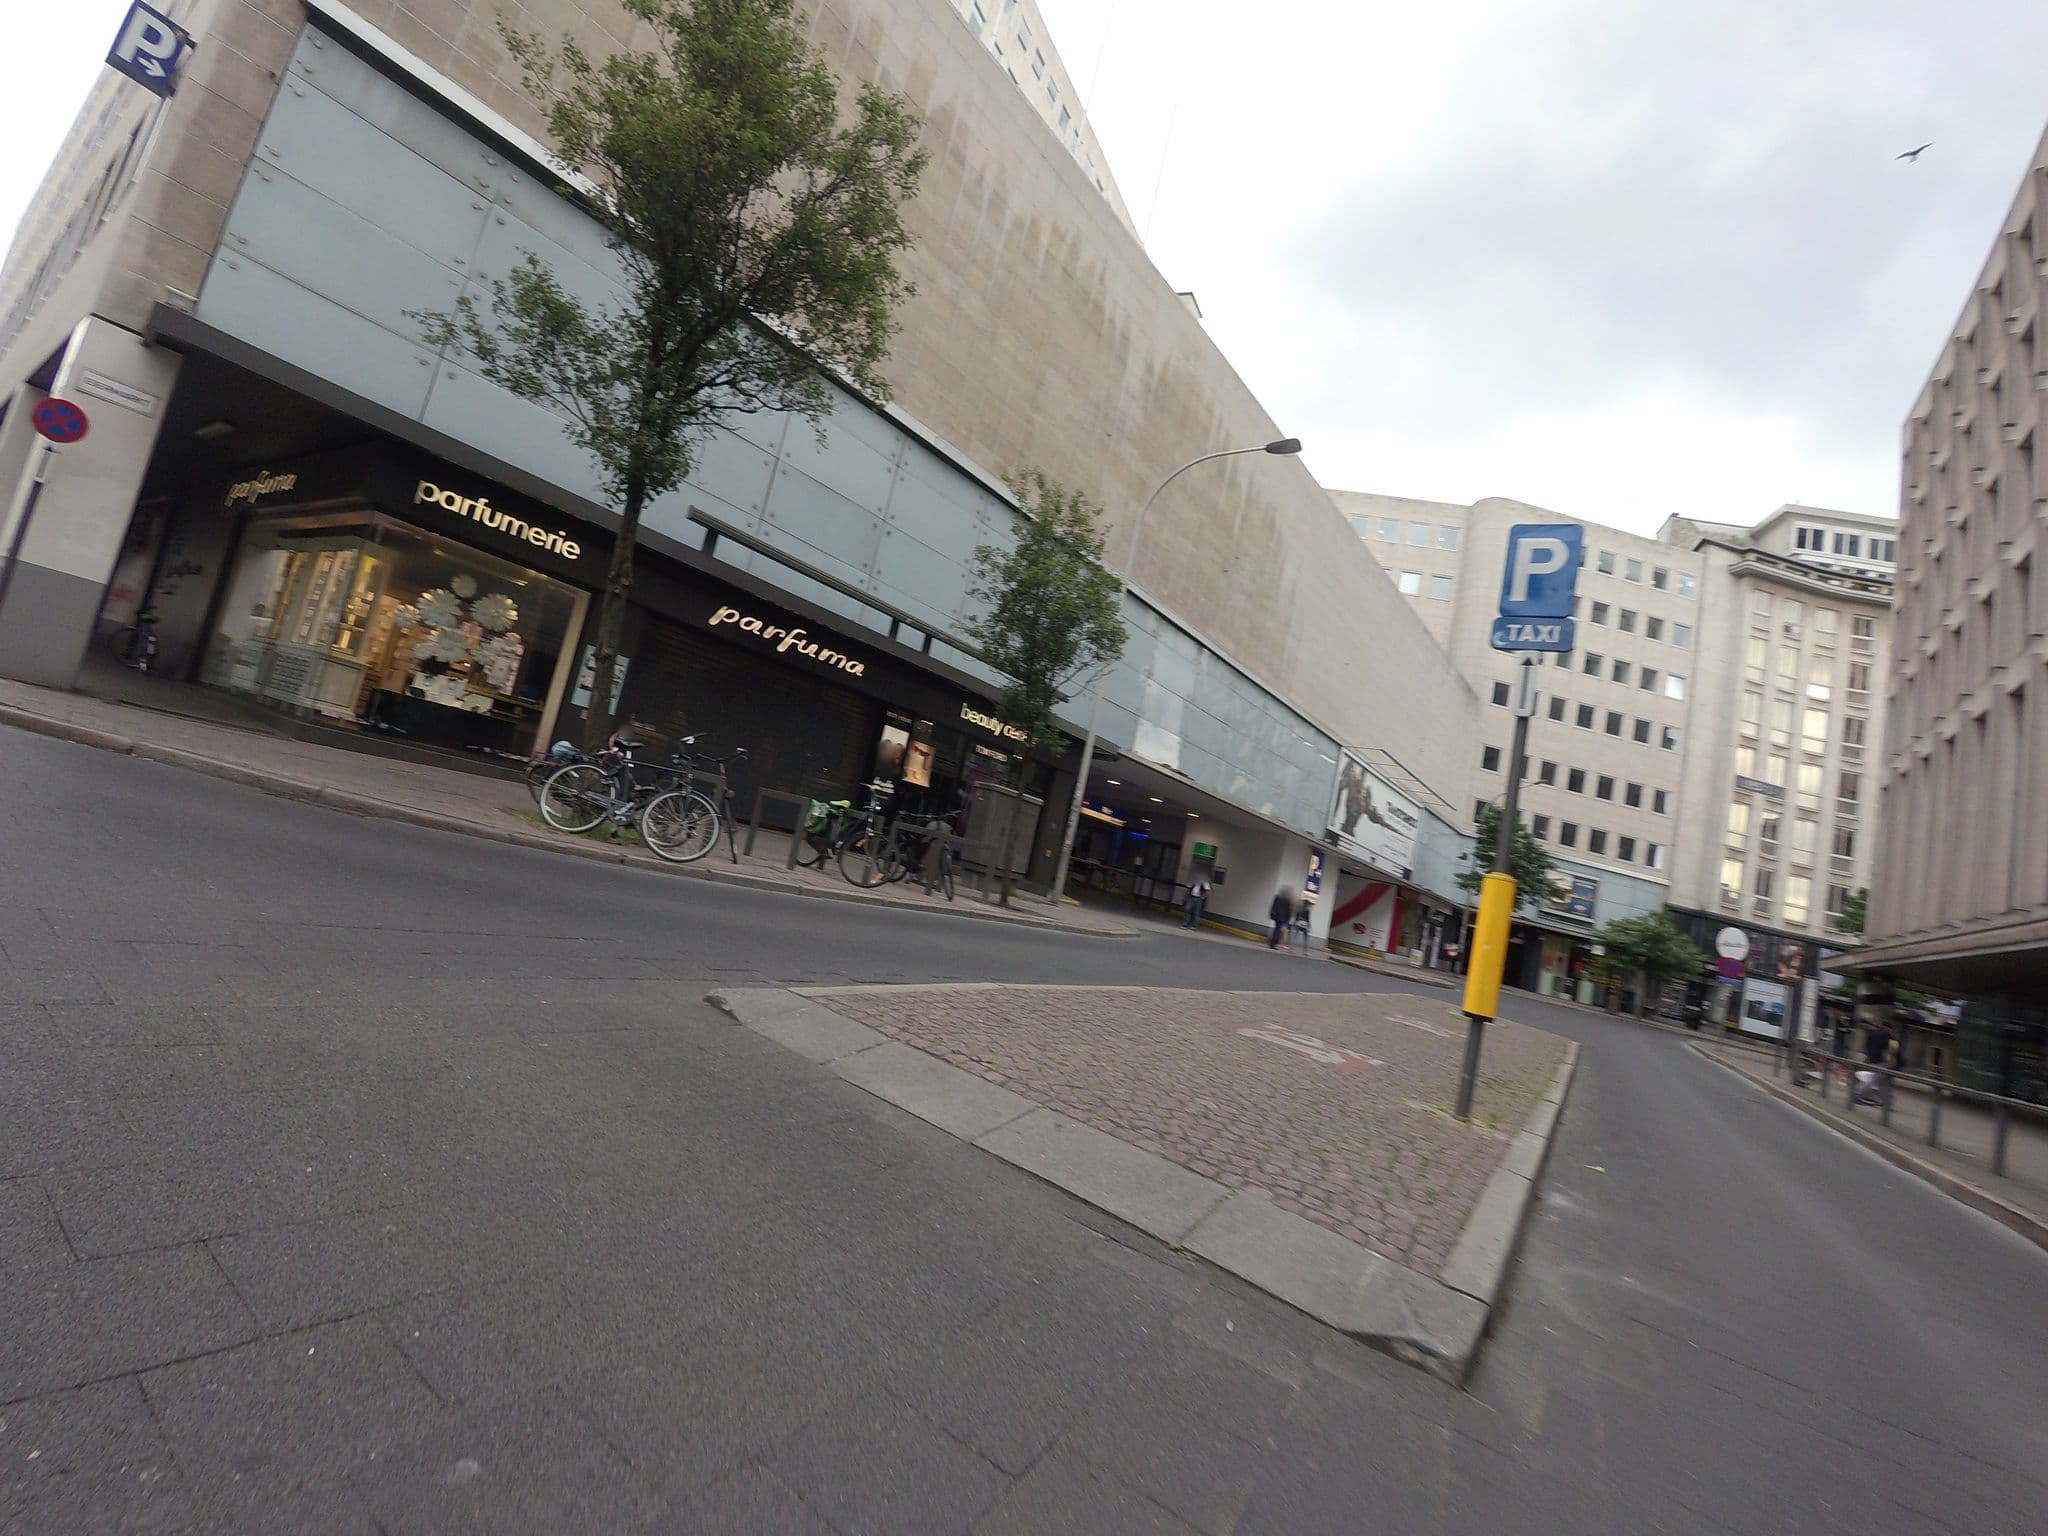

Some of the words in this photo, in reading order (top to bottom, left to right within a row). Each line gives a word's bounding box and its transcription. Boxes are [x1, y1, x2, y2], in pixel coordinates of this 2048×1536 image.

[115, 6, 177, 63] P
[413, 479, 581, 560] parfumerie
[1509, 538, 1569, 601] P
[708, 605, 865, 676] parfuma
[1507, 624, 1561, 642] TAXI
[960, 702, 1004, 736] beauty
